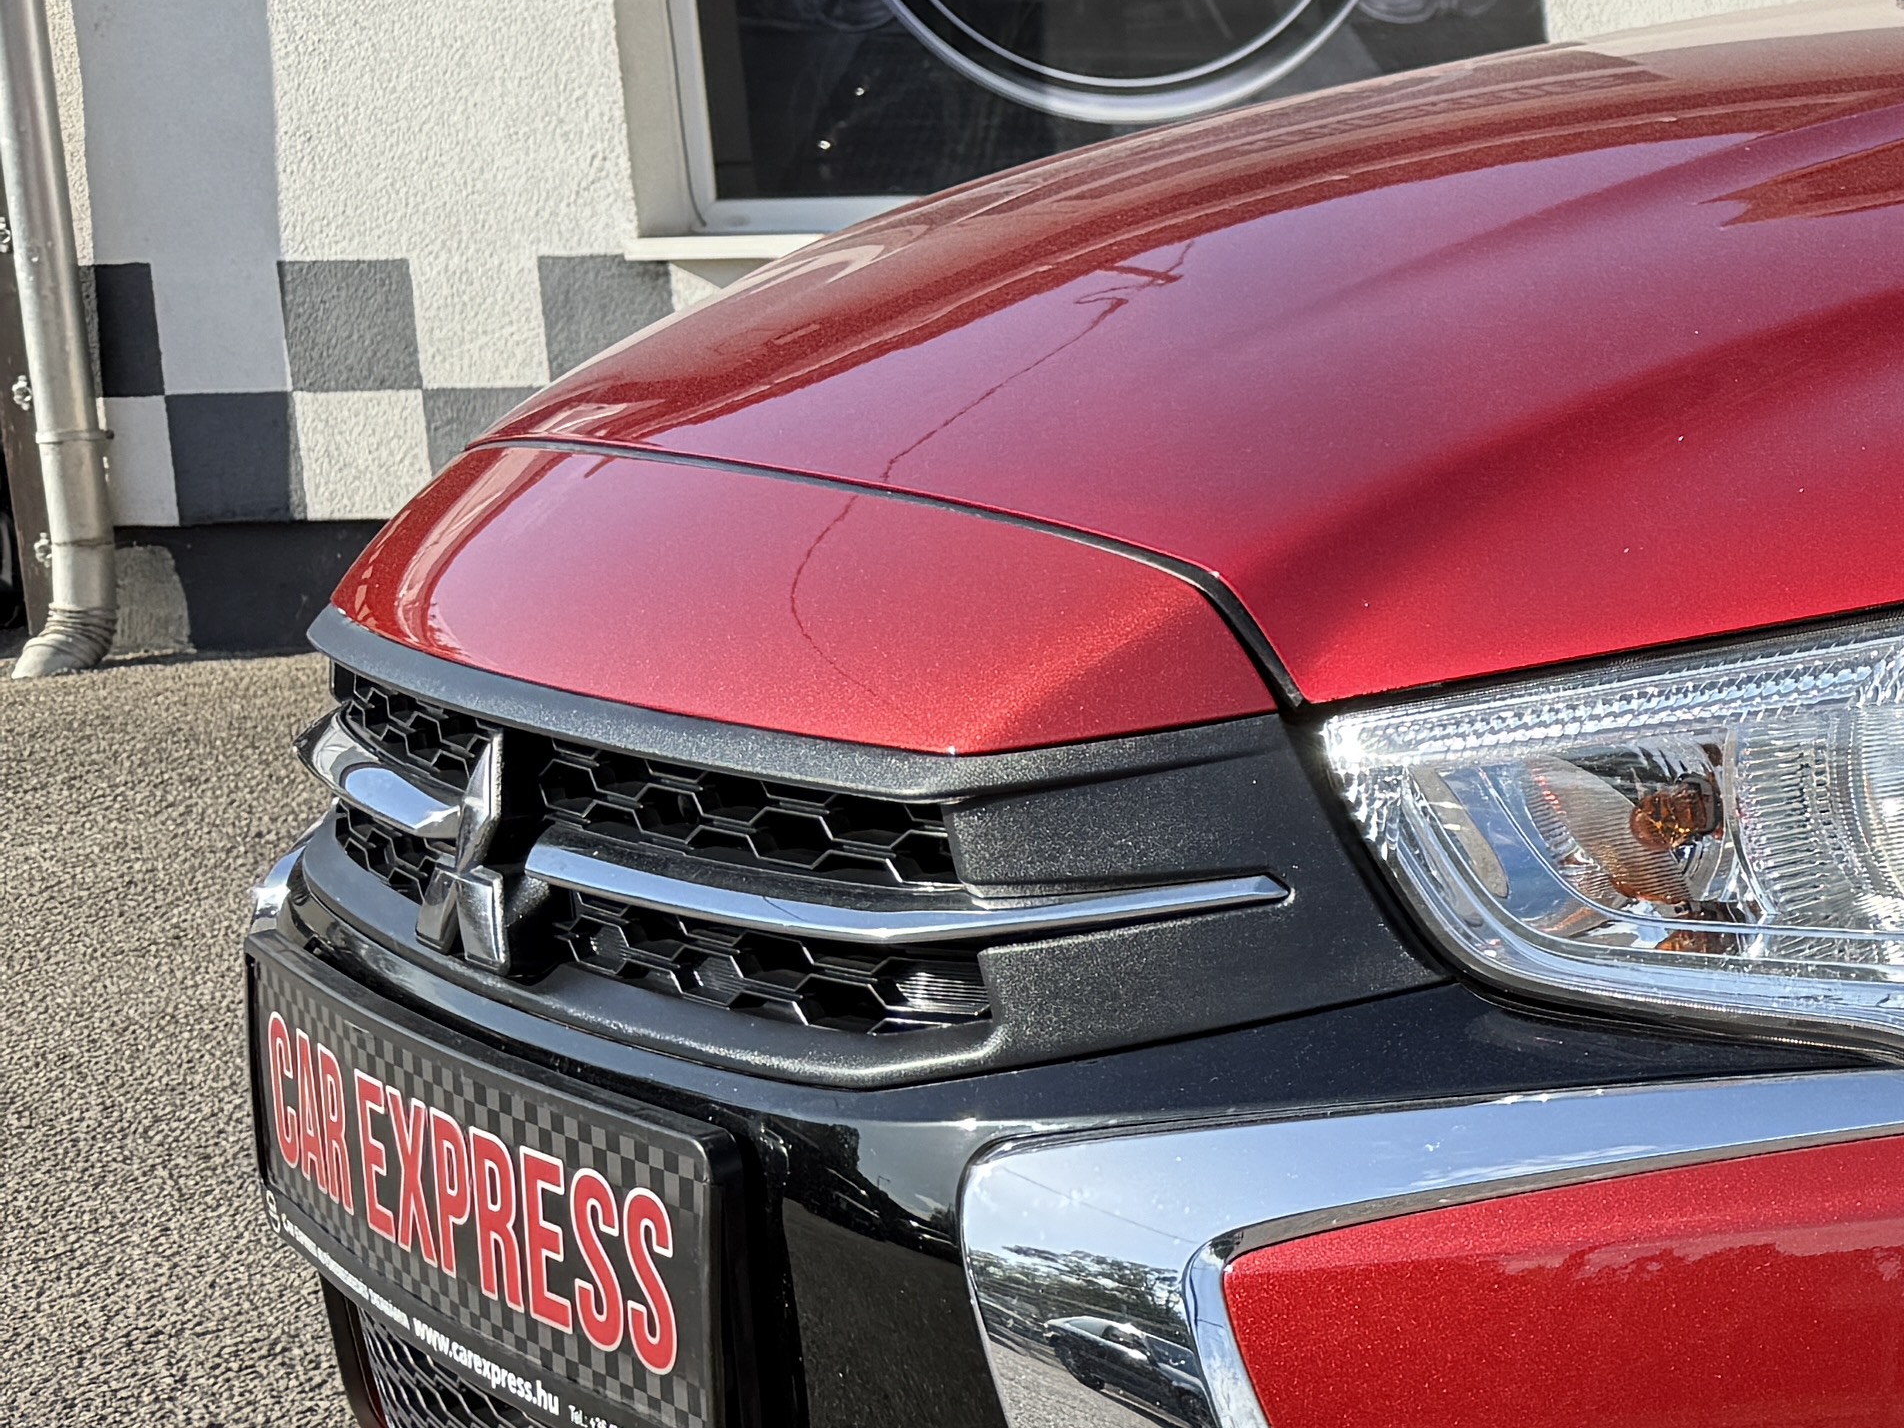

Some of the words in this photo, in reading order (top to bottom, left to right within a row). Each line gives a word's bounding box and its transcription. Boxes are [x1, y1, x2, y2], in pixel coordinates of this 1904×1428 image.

[267, 1010, 354, 1216] CAR
[354, 1068, 677, 1375] EXPRESS
[413, 1317, 560, 1416] www.carexpress.hu
